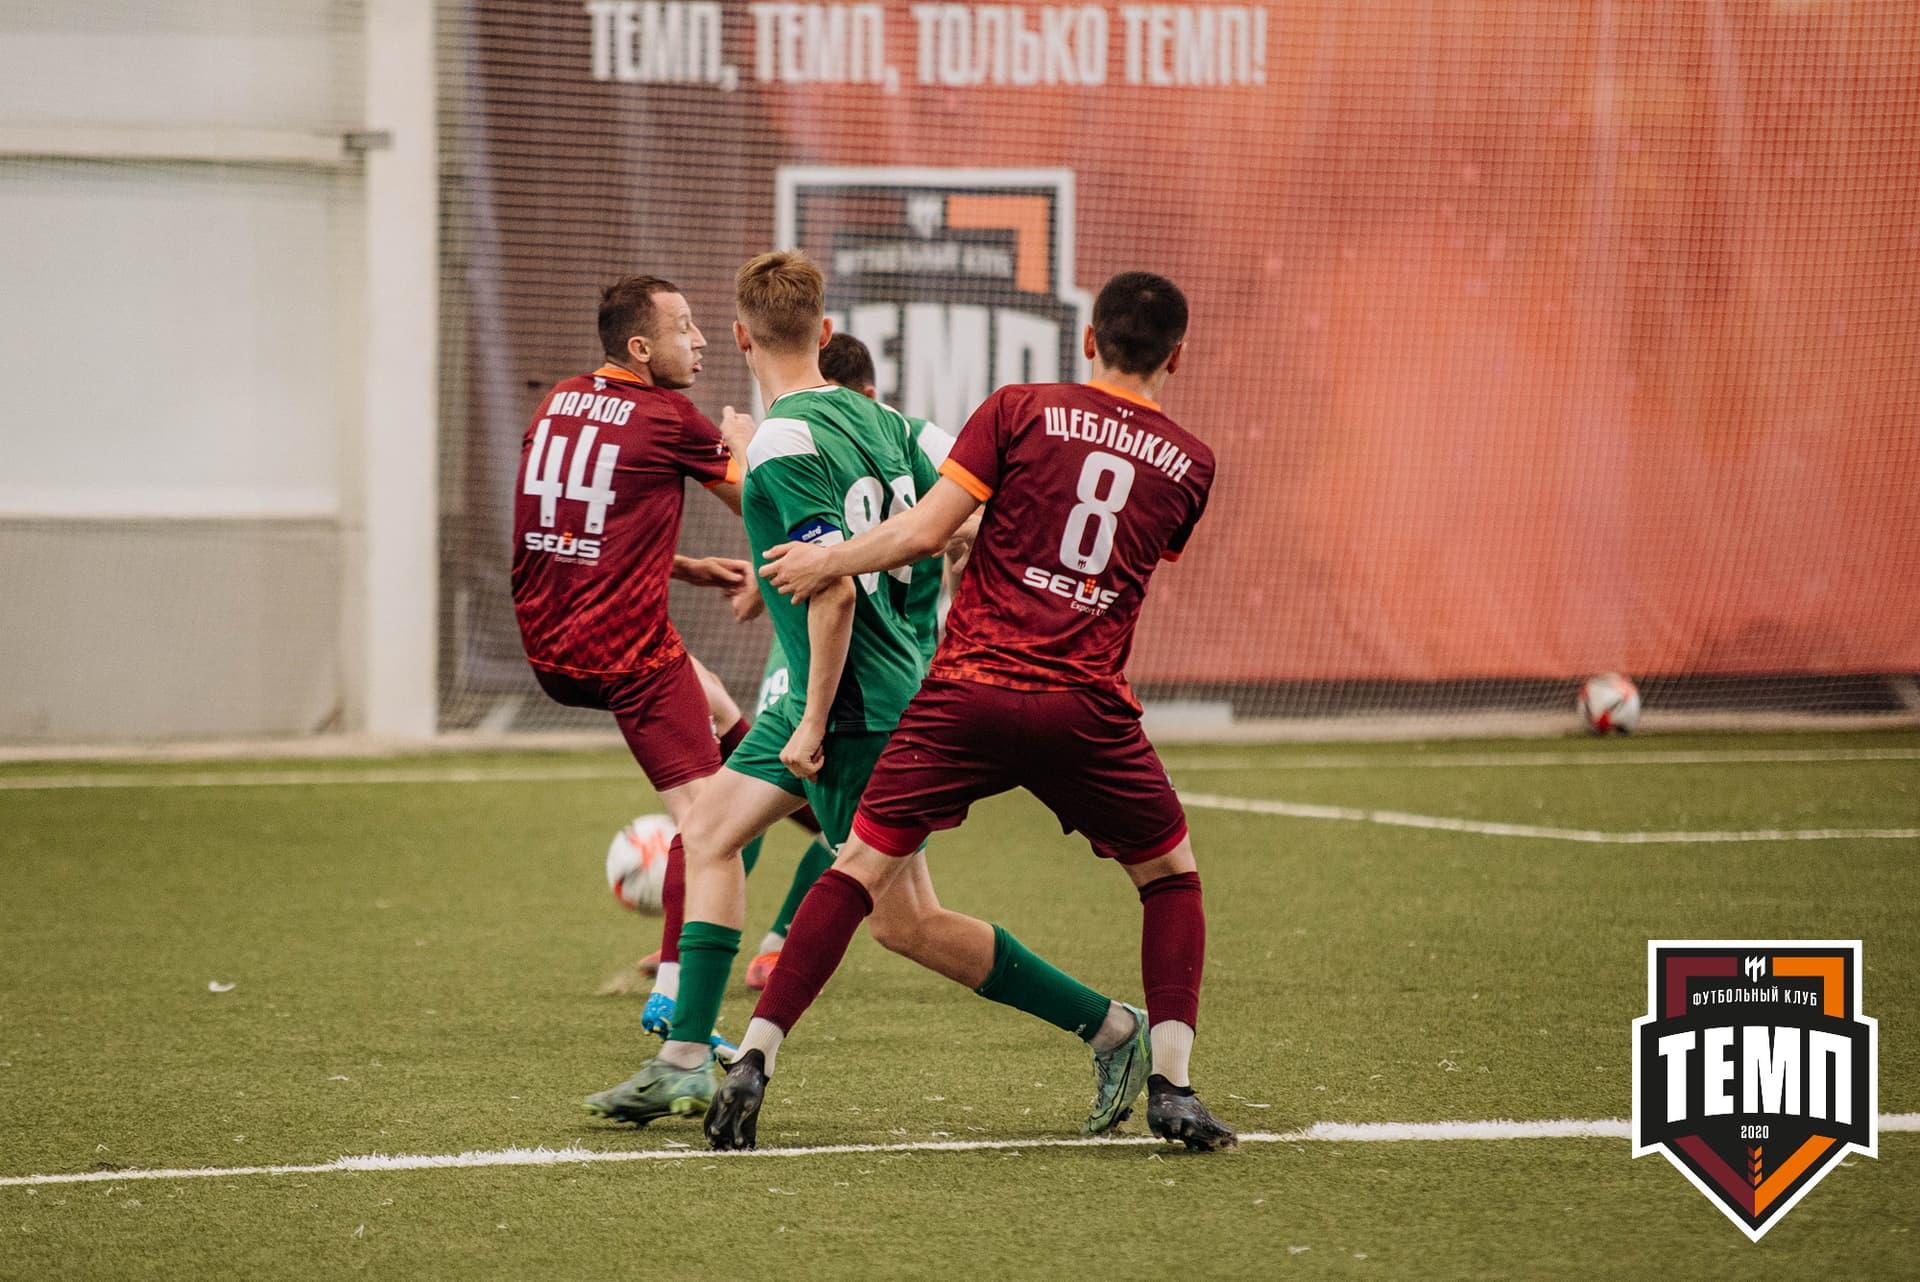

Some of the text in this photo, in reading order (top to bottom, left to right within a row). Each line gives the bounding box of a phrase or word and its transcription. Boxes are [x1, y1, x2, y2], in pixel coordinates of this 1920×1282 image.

[586, 1, 1268, 94] ТЕМП, ТЕМП, ТОЛЬКО ТЕМП!
[546, 391, 636, 426] МАРКОВ
[823, 302, 1060, 434] ЕМП
[523, 418, 621, 535] 44
[1044, 407, 1192, 483] ЩЕБЛЫКИН
[1059, 451, 1136, 575] 8
